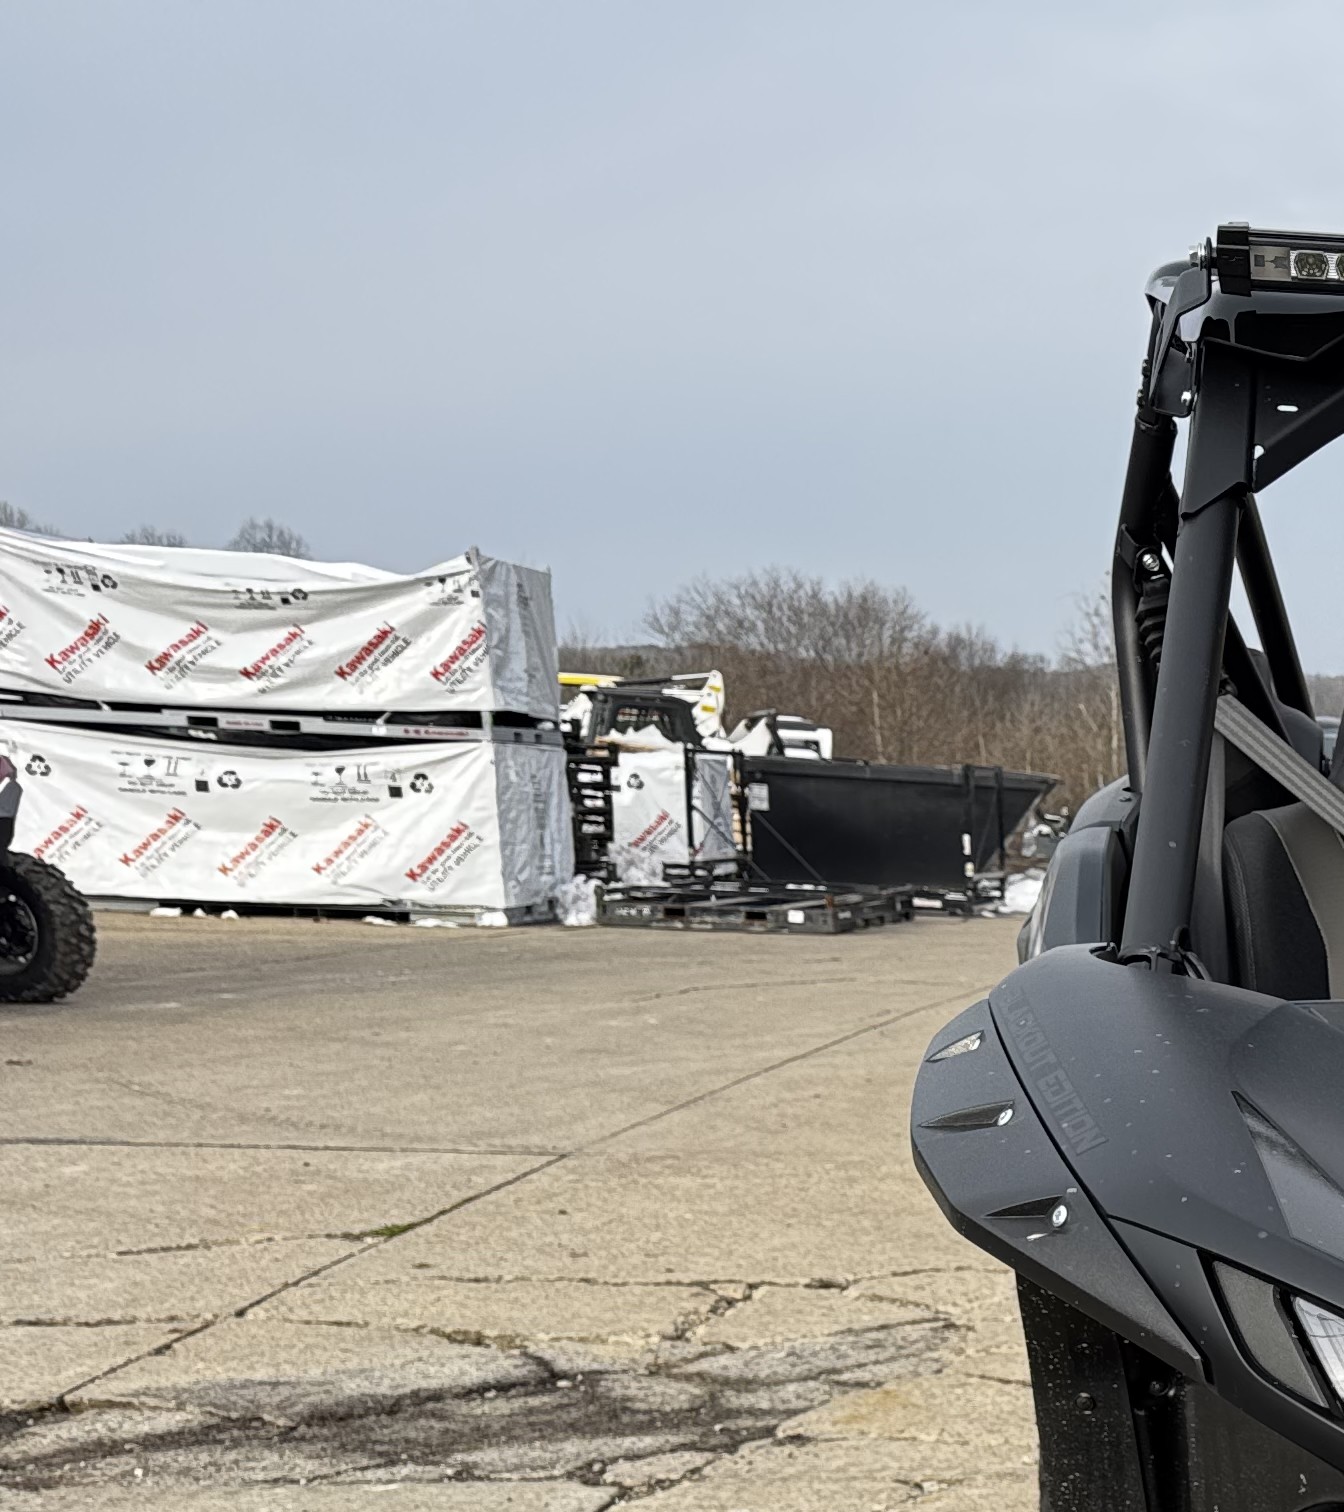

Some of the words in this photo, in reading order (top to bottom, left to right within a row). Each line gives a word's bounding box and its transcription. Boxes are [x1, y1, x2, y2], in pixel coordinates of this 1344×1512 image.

[44, 612, 110, 670] Kawasaki
[145, 619, 209, 675] Kawasaki
[239, 622, 306, 681] Kawasaki
[334, 620, 396, 681] Kawasaki
[34, 805, 88, 860] awasaki
[119, 806, 187, 868] Kawasaki
[218, 815, 284, 877] Kawasaki
[404, 819, 470, 883] Kawasaki
[1035, 1069, 1110, 1157] EDITION
